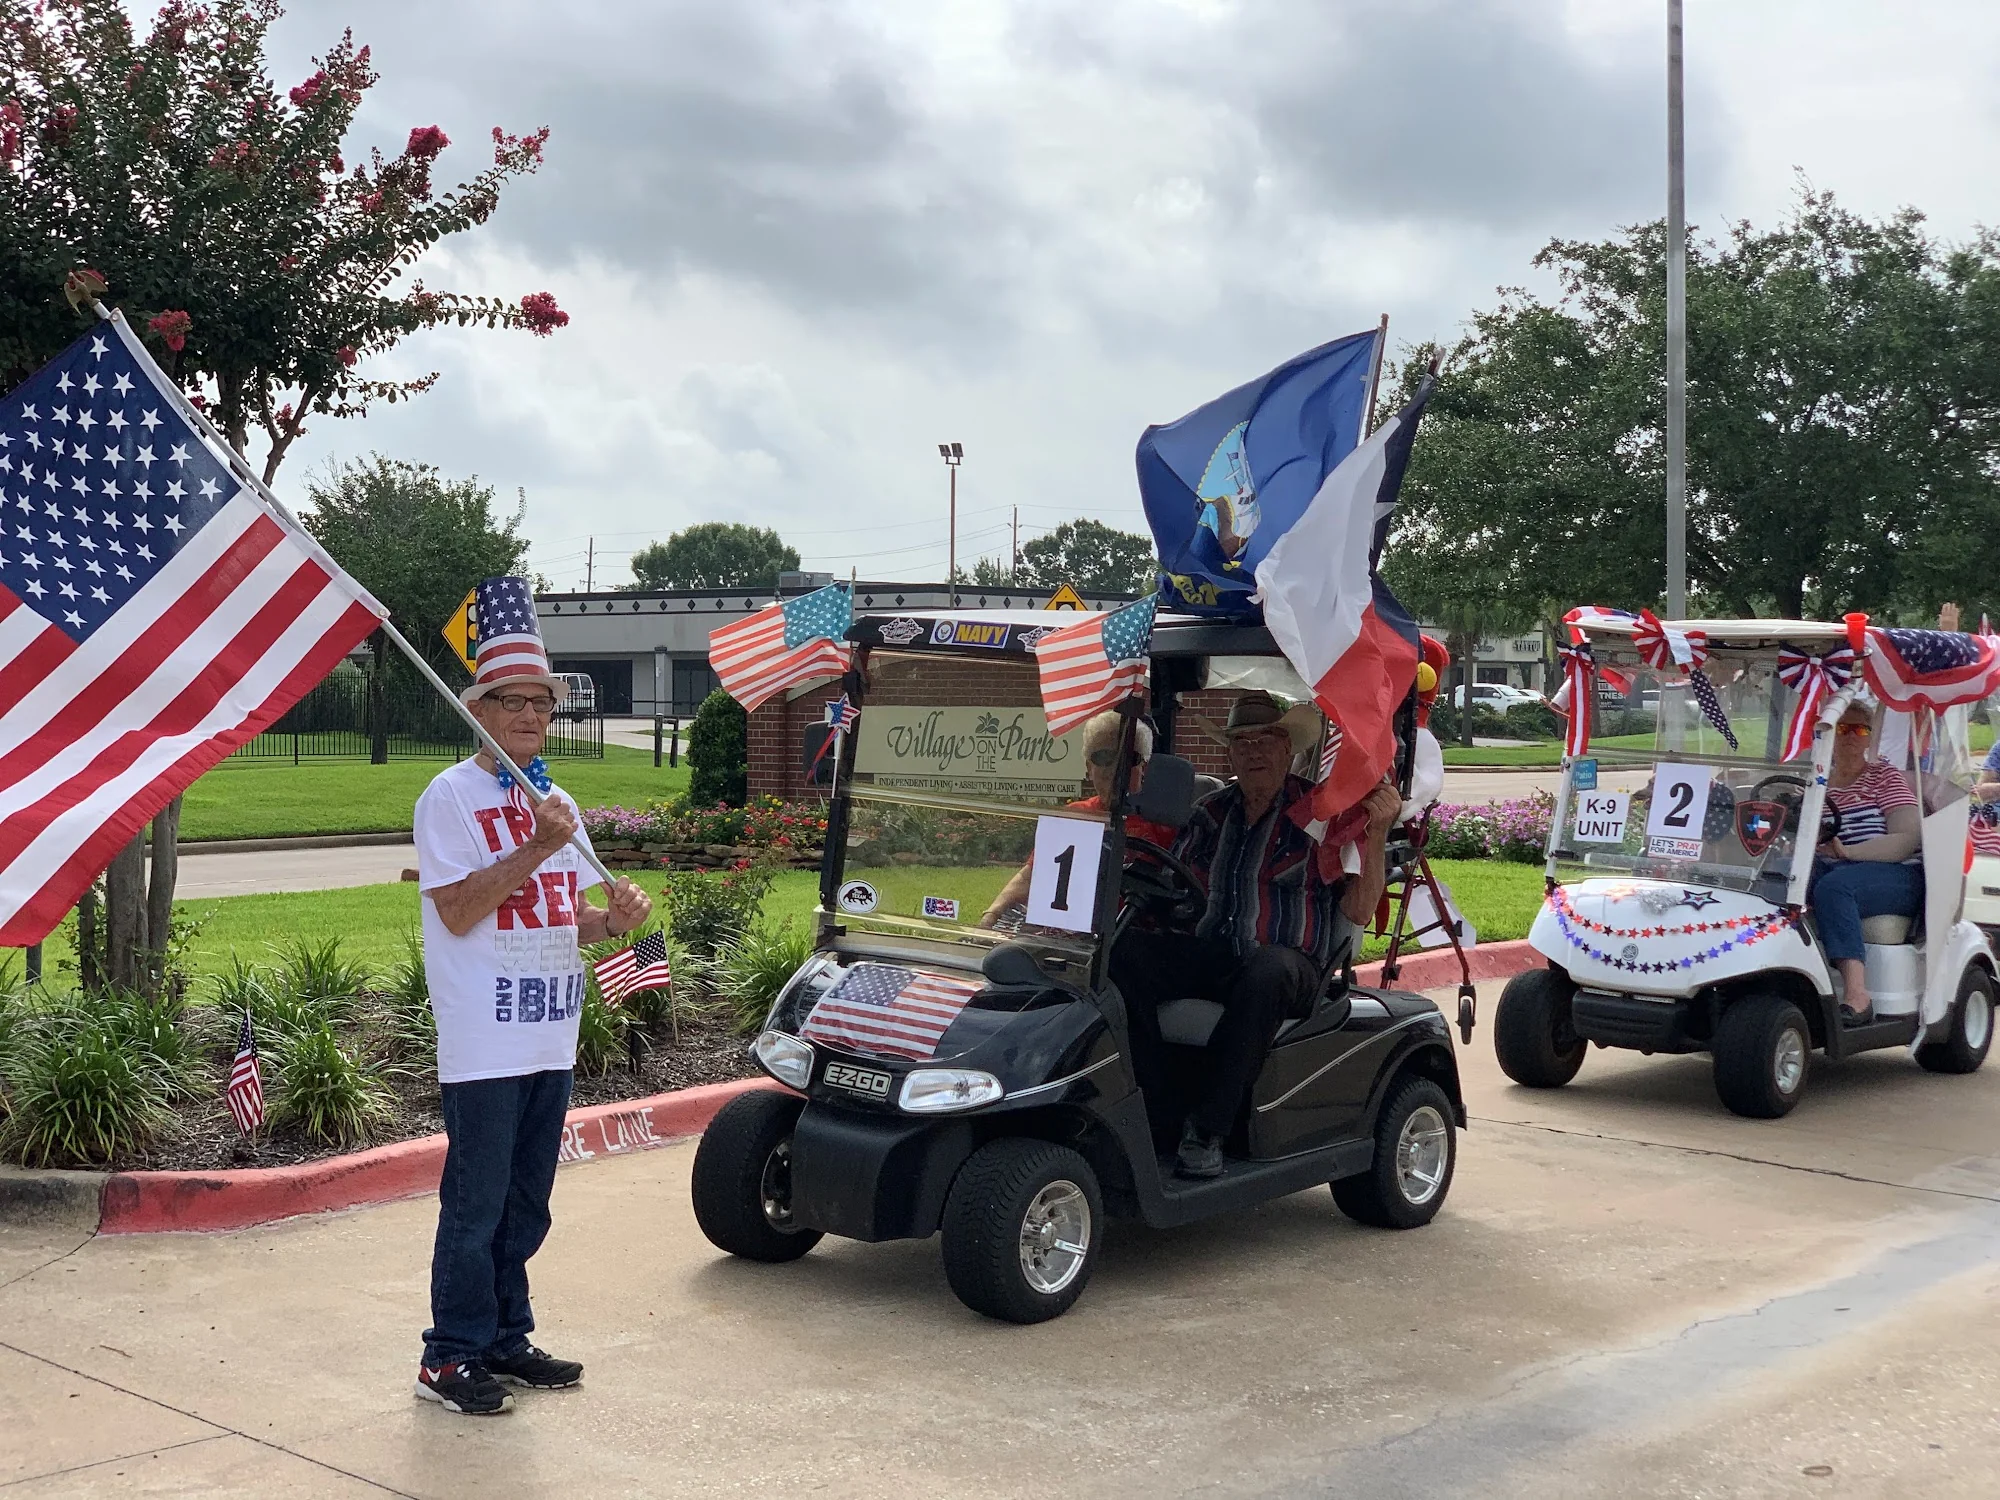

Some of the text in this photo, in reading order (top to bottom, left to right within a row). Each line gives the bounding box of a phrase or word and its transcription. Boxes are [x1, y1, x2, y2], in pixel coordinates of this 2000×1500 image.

[954, 624, 1006, 645] NAVY
[1599, 692, 1624, 700] TNES
[887, 711, 1069, 772] Village ON THE Park
[879, 777, 1076, 793] INDEPENDENT LIVING ASSISTED LIVING MEMORY CARE
[1586, 798, 1616, 814] K-9
[1663, 782, 1694, 828] 2
[474, 805, 536, 854] TR
[1578, 820, 1623, 837] UNIT
[1651, 838, 1701, 851] LET'S PRAY
[1649, 846, 1699, 858] FOR AMERICA
[1050, 844, 1075, 912] 1
[924, 896, 956, 919] USA
[495, 930, 581, 973] WHI
[496, 977, 513, 1022] AND
[518, 972, 585, 1023] BLU
[558, 1107, 661, 1161] RE LANE
